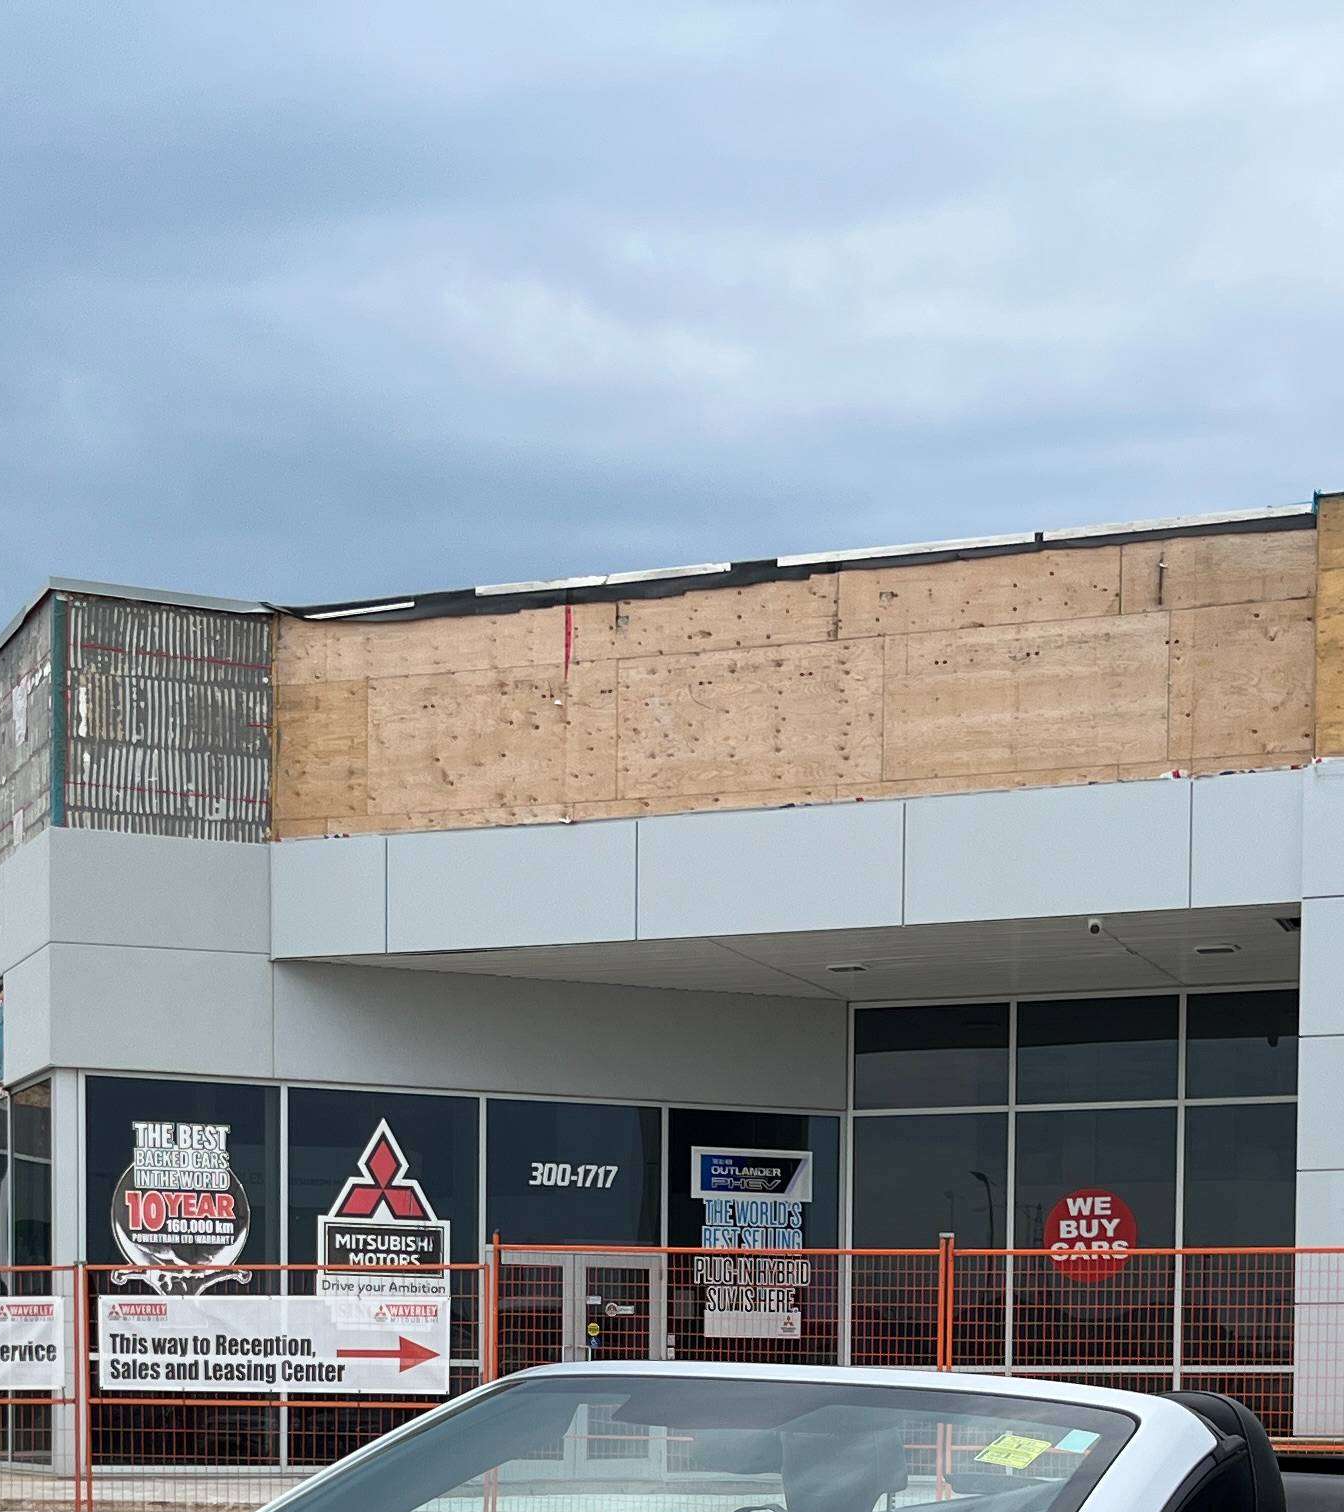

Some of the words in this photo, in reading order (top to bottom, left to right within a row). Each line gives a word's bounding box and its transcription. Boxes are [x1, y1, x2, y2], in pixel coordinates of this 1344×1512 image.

[132, 1122, 174, 1149] THE
[177, 1123, 230, 1151] BEST
[135, 1150, 189, 1168] BACKED
[192, 1151, 229, 1169] CARS
[136, 1169, 151, 1188] IN
[152, 1169, 178, 1188] THE
[179, 1170, 229, 1189] WORLD
[529, 1162, 618, 1188] 300-1717
[711, 1165, 781, 1177] OUTLANDER
[712, 1177, 782, 1190] PHEV
[125, 1191, 166, 1231] 10
[163, 1192, 236, 1219] YEAR
[704, 1200, 733, 1225] THE
[736, 1200, 803, 1228] WORLD'S
[1066, 1196, 1112, 1216] WE
[166, 1219, 213, 1233] 160,000
[215, 1221, 234, 1234] km
[1059, 1218, 1121, 1239] BUY
[132, 1233, 180, 1243] POWERTRAIN
[335, 1233, 434, 1252] MITSUBISHI
[348, 1252, 421, 1266] MOTORS
[1050, 1240, 1129, 1261] CARS
[694, 1256, 754, 1285] PLUG-IN
[756, 1258, 811, 1287] HYBRID
[322, 1279, 355, 1291] Drive
[357, 1282, 387, 1295] your
[389, 1281, 447, 1294] Ambition
[121, 1304, 167, 1315] WAVERLEY
[389, 1305, 437, 1316] WAVERLEY
[109, 1333, 149, 1355] This
[152, 1336, 189, 1357] way
[193, 1335, 211, 1356] to
[215, 1334, 317, 1359] Reception,
[110, 1358, 161, 1381] Sales
[165, 1359, 200, 1380] and
[205, 1359, 277, 1384] Leasing
[281, 1360, 346, 1383] Center
